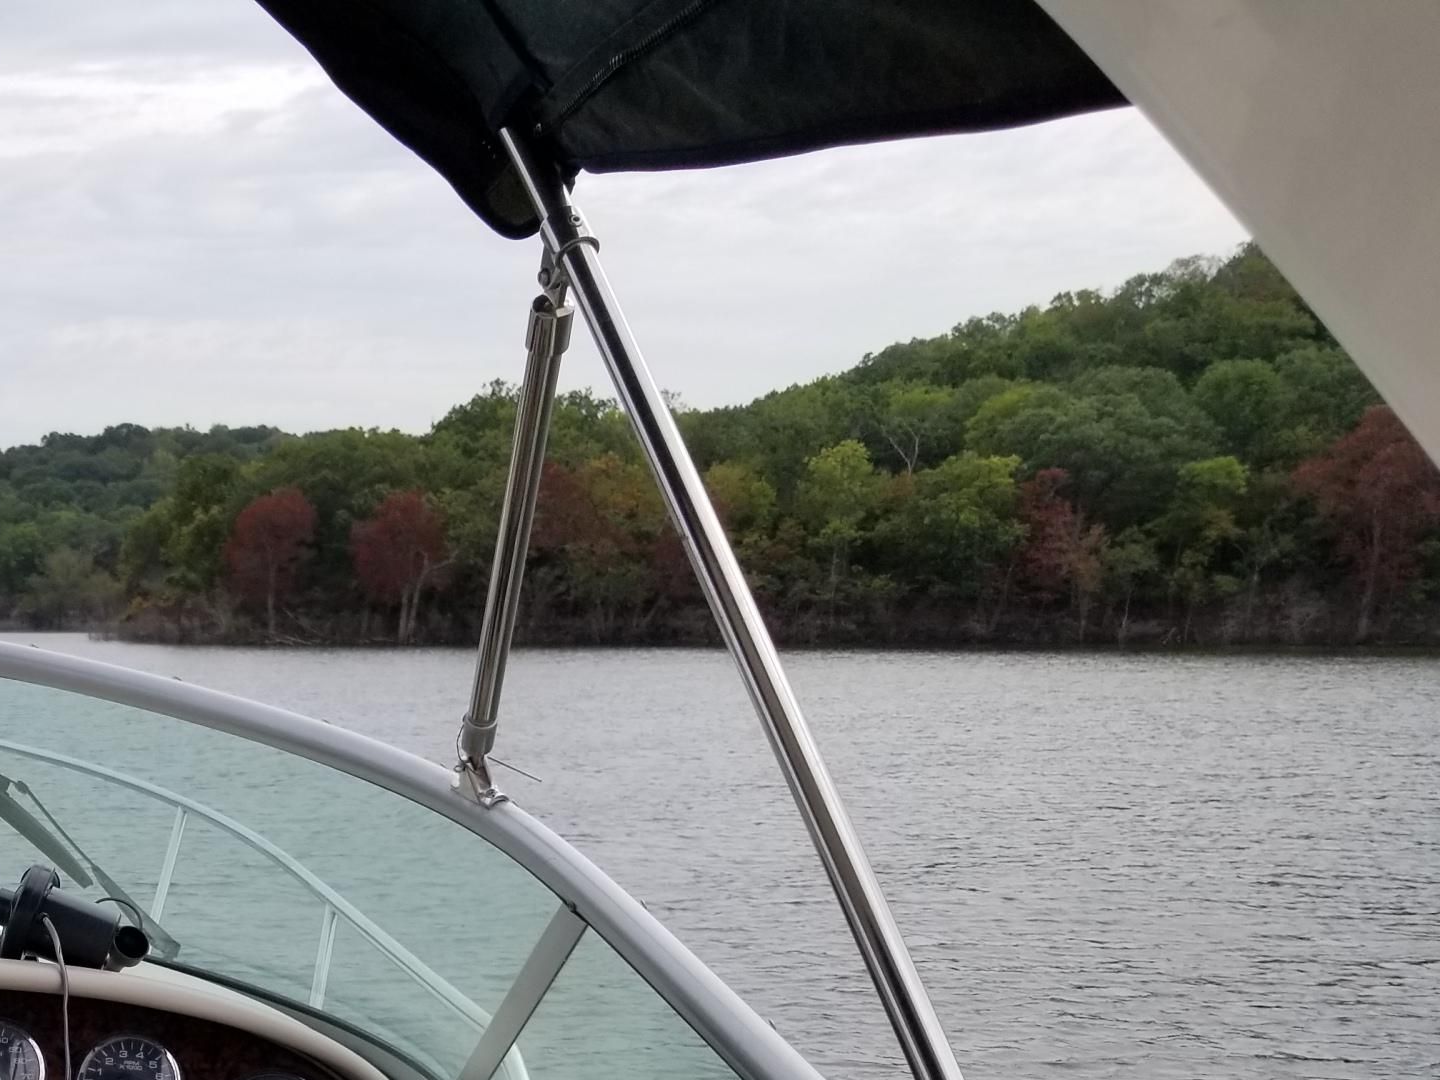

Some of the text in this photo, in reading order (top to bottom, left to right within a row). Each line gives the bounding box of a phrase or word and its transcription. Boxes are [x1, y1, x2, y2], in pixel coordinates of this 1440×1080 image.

[119, 1050, 128, 1058] 3
[105, 1057, 114, 1065] 2
[149, 1061, 158, 1069] 5
